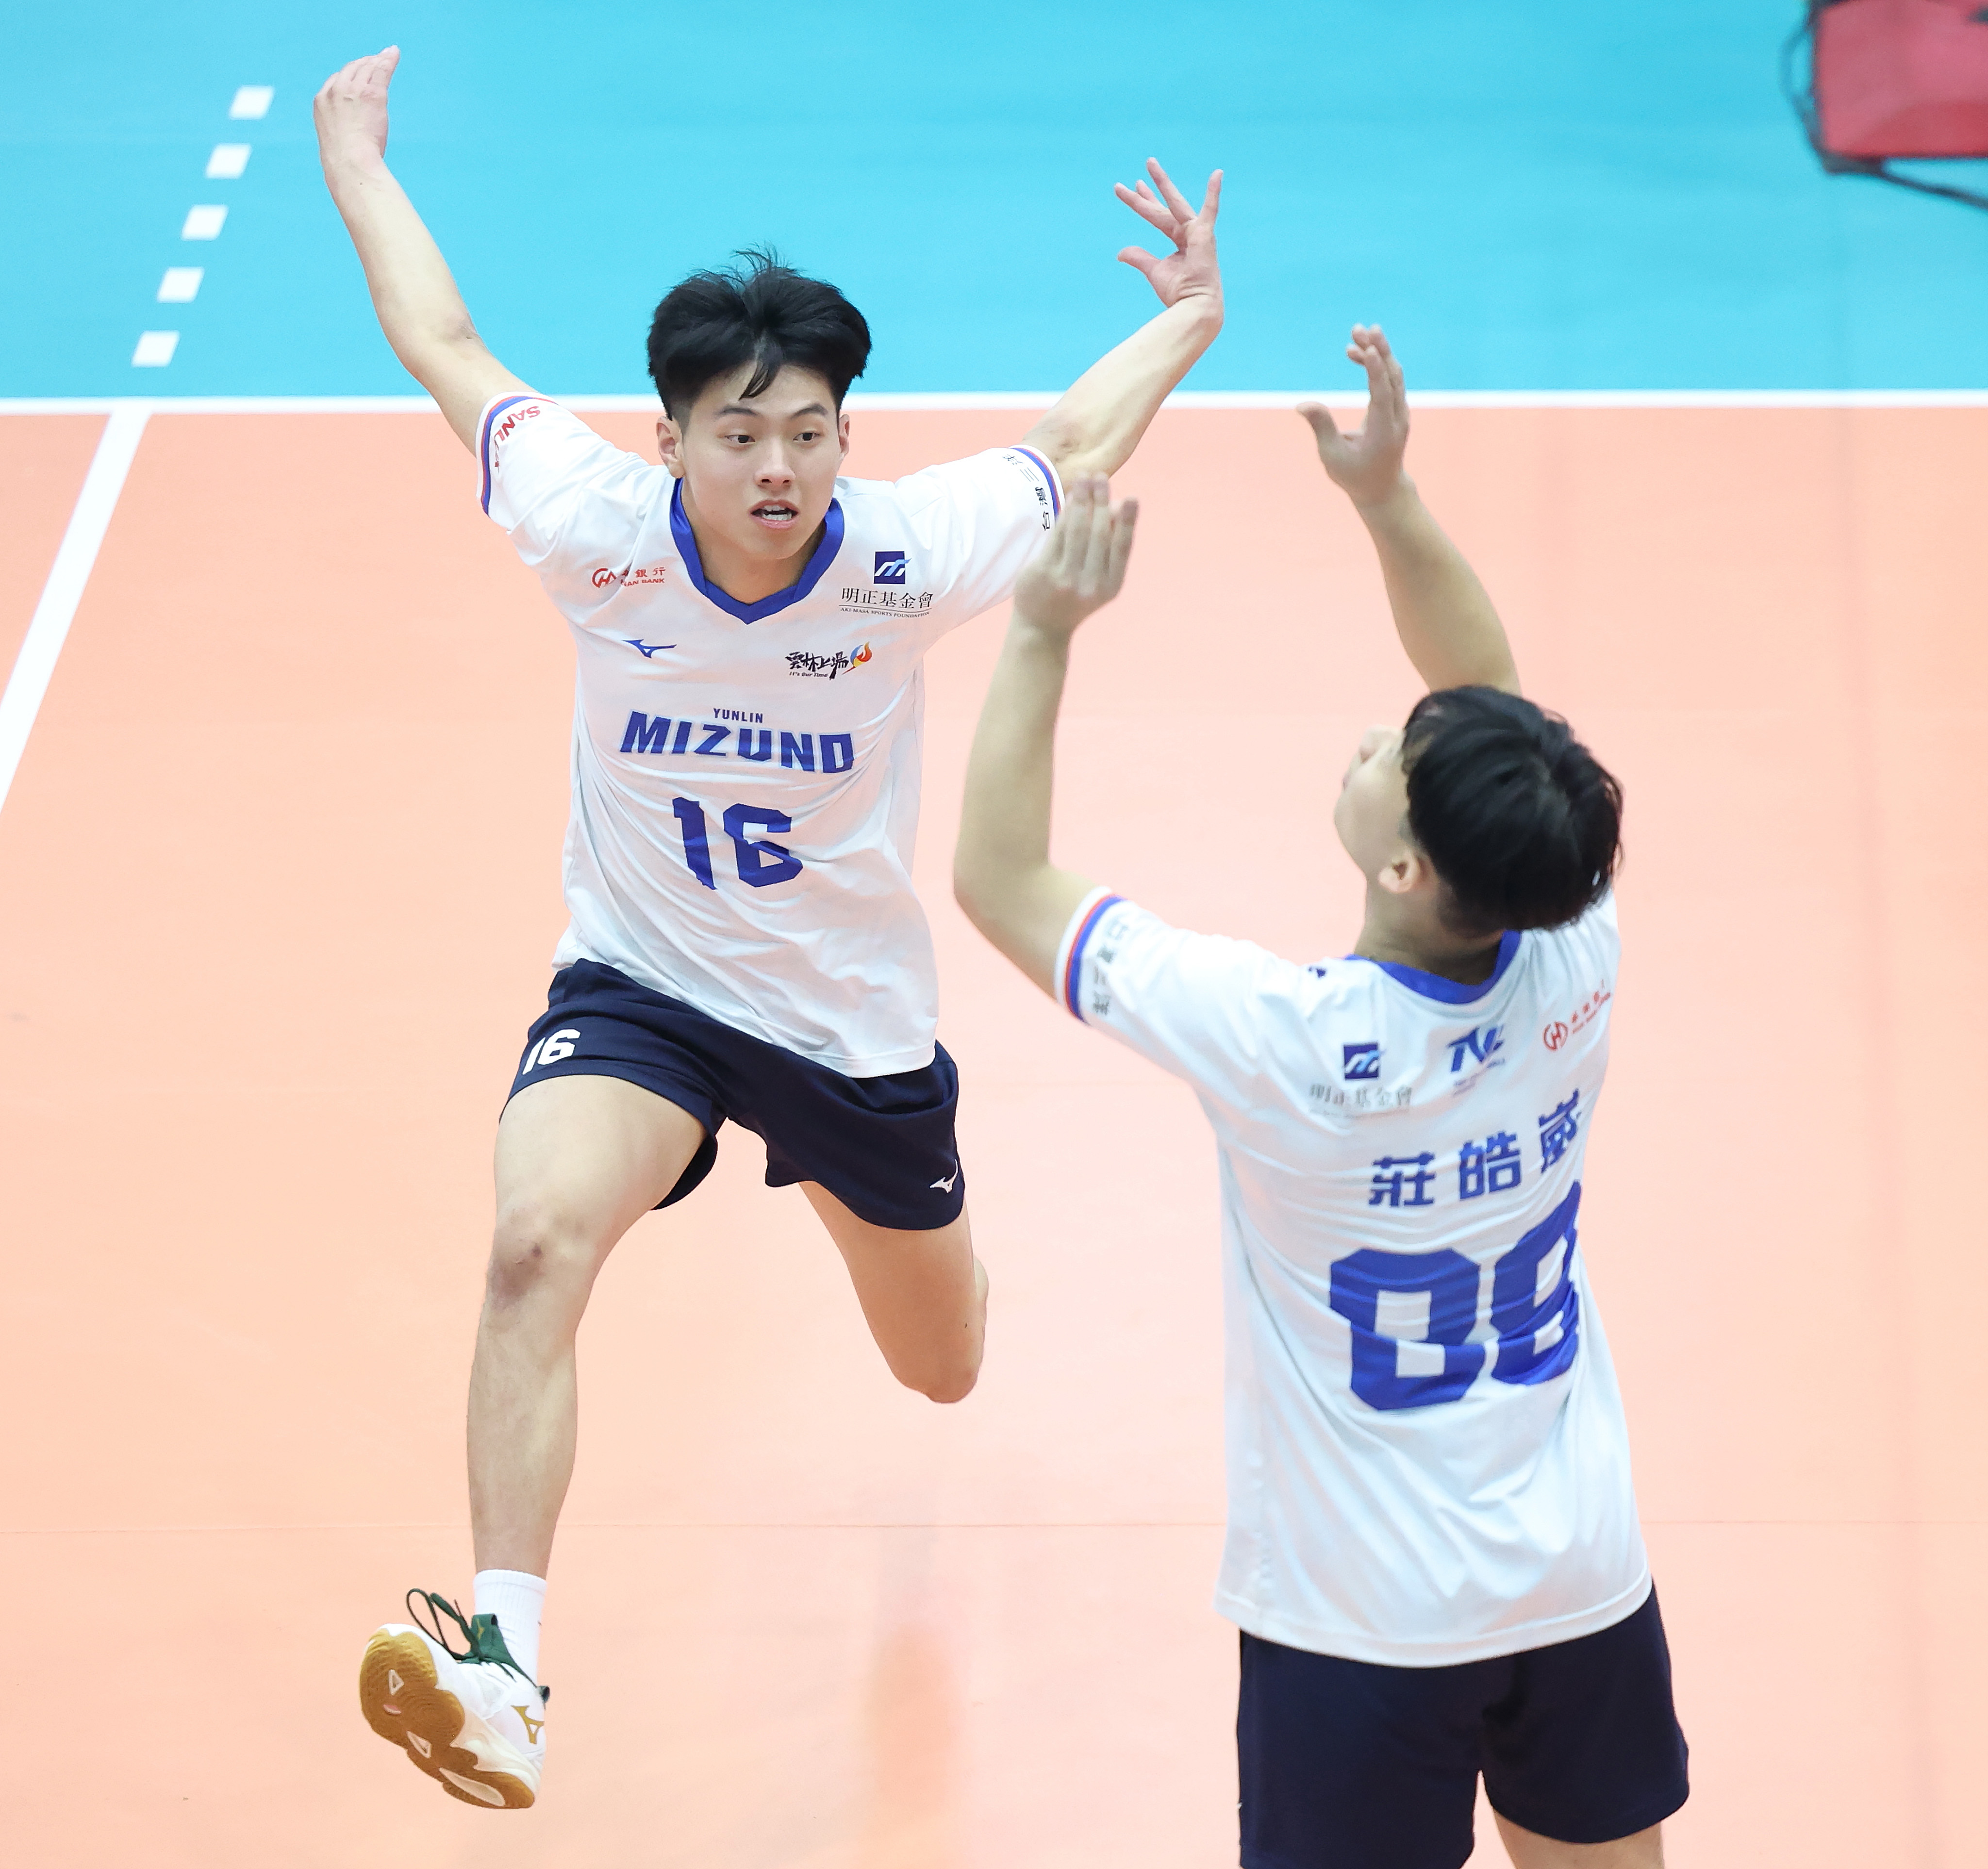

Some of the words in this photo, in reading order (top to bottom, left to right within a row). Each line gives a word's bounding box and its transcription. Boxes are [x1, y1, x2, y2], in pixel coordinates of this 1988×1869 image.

[842, 587, 934, 609] 明正基金會
[714, 708, 763, 723] YUNLIN
[620, 710, 855, 773] MIZUNO
[673, 797, 803, 890] 16
[522, 1029, 580, 1075] 16
